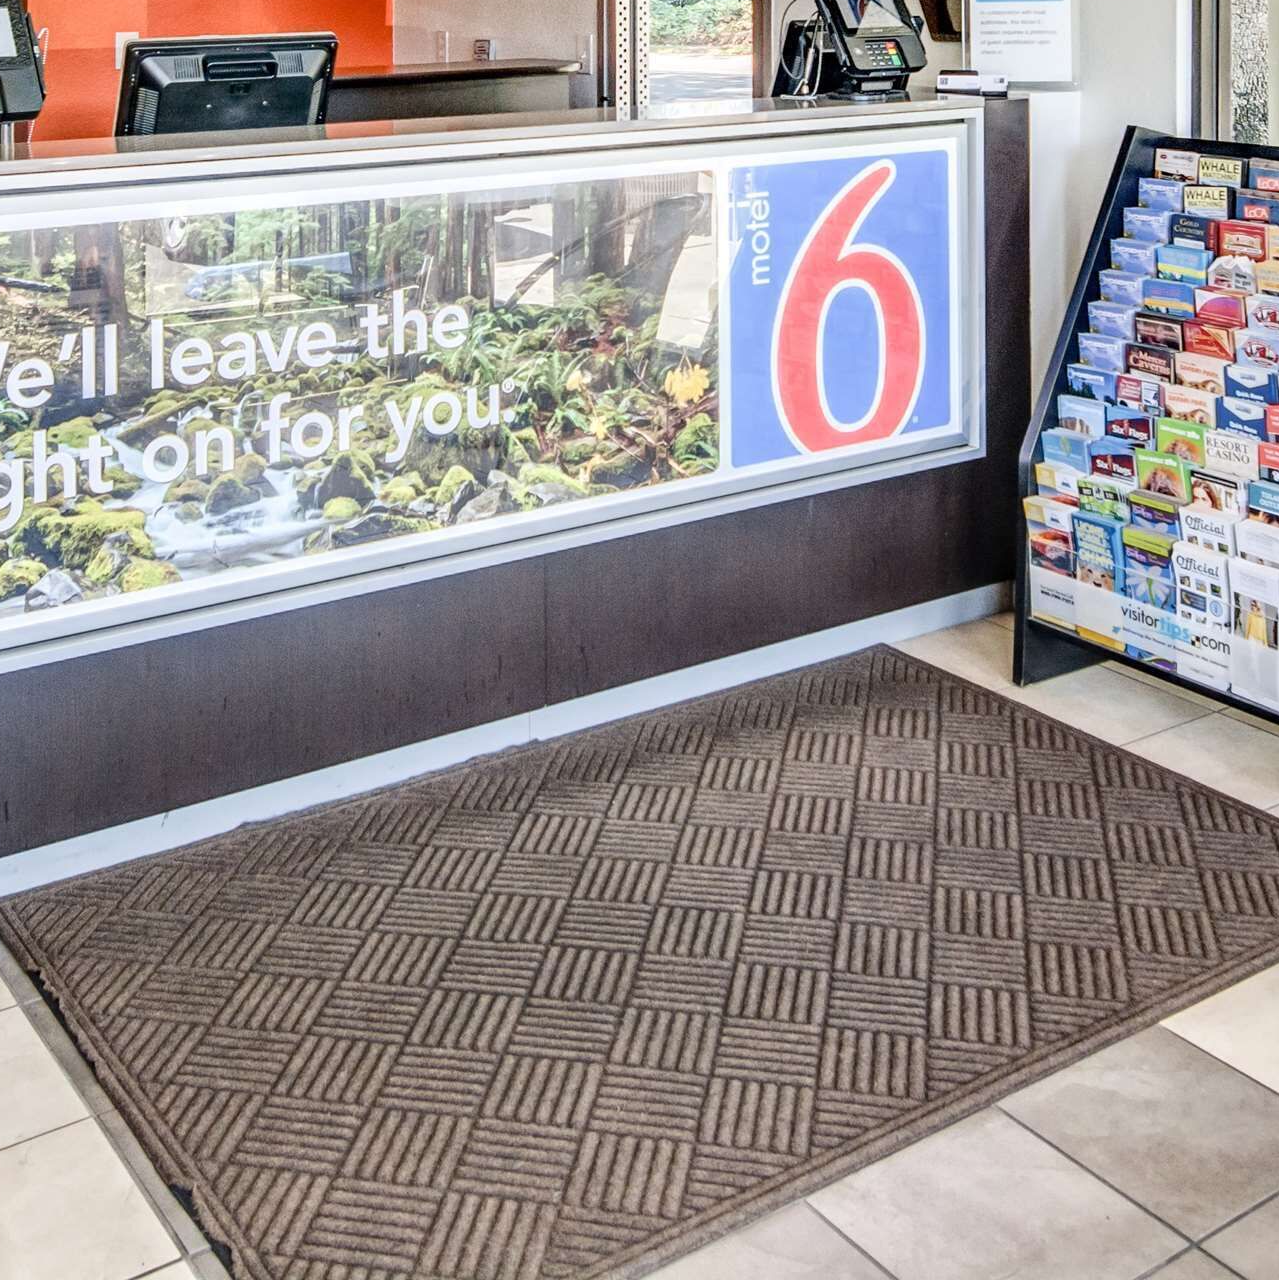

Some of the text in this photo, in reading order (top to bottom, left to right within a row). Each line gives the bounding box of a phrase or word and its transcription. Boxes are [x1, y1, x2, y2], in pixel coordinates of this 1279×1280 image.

[1200, 161, 1240, 175] WHALE
[1186, 189, 1226, 201] WHALE
[746, 190, 770, 285] motel
[771, 159, 926, 454] 6
[151, 319, 337, 389] leave
[360, 286, 469, 359] the
[142, 425, 234, 483] on
[261, 392, 363, 463] for
[1206, 436, 1249, 454] RESORT
[1206, 445, 1250, 465] CASINO
[1185, 515, 1225, 535] Official
[1176, 555, 1219, 577] Official
